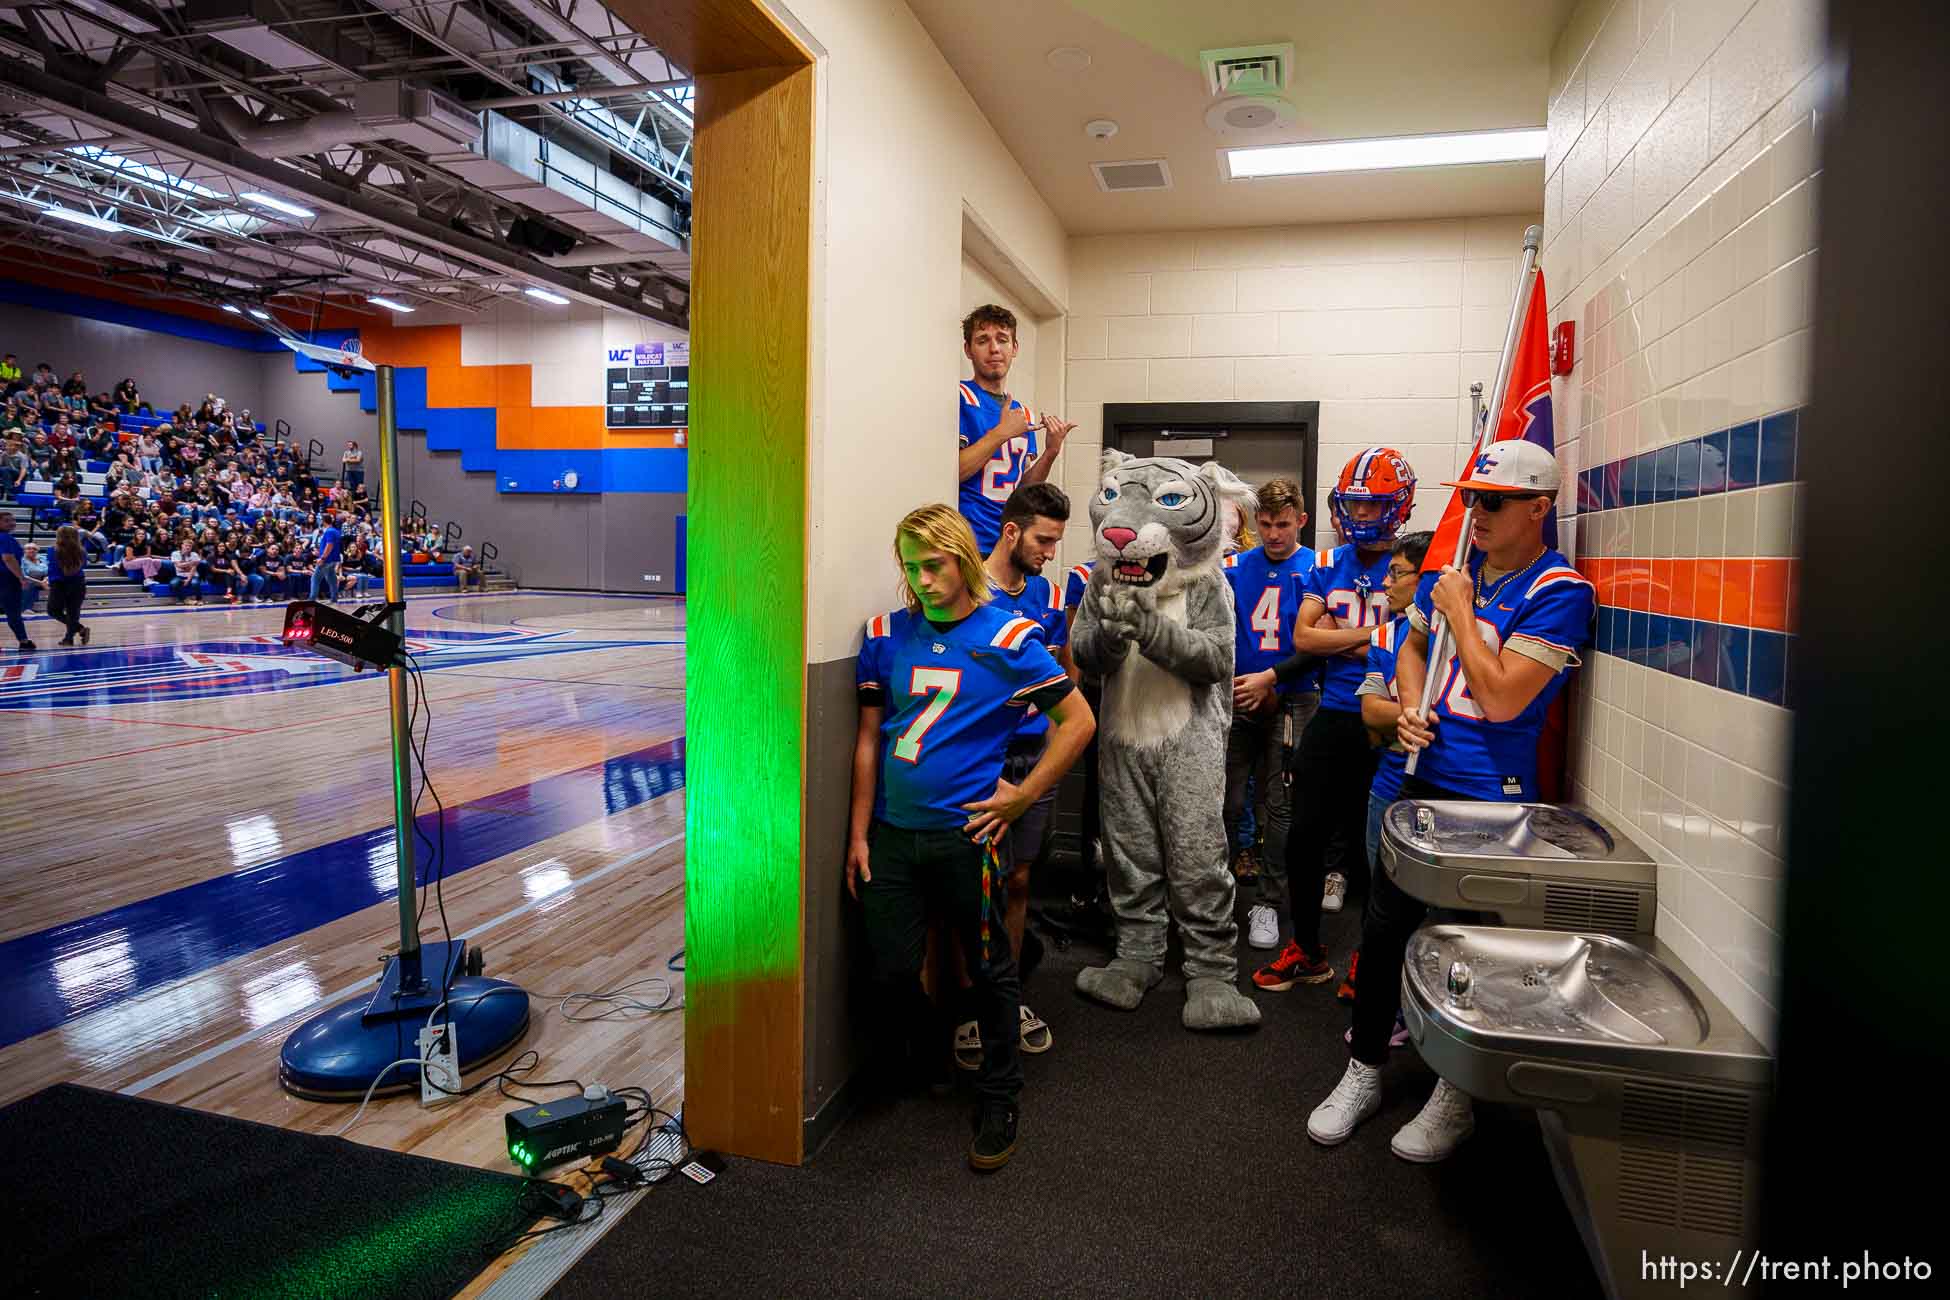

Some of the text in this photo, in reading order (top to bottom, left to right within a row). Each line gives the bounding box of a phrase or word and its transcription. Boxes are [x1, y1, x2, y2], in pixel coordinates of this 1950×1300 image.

[608, 349, 632, 361] WC
[981, 436, 1029, 502] 27
[320, 626, 353, 645] LED-500
[1251, 586, 1281, 650] 4
[893, 665, 963, 765] 7
[1507, 776, 1516, 784] M
